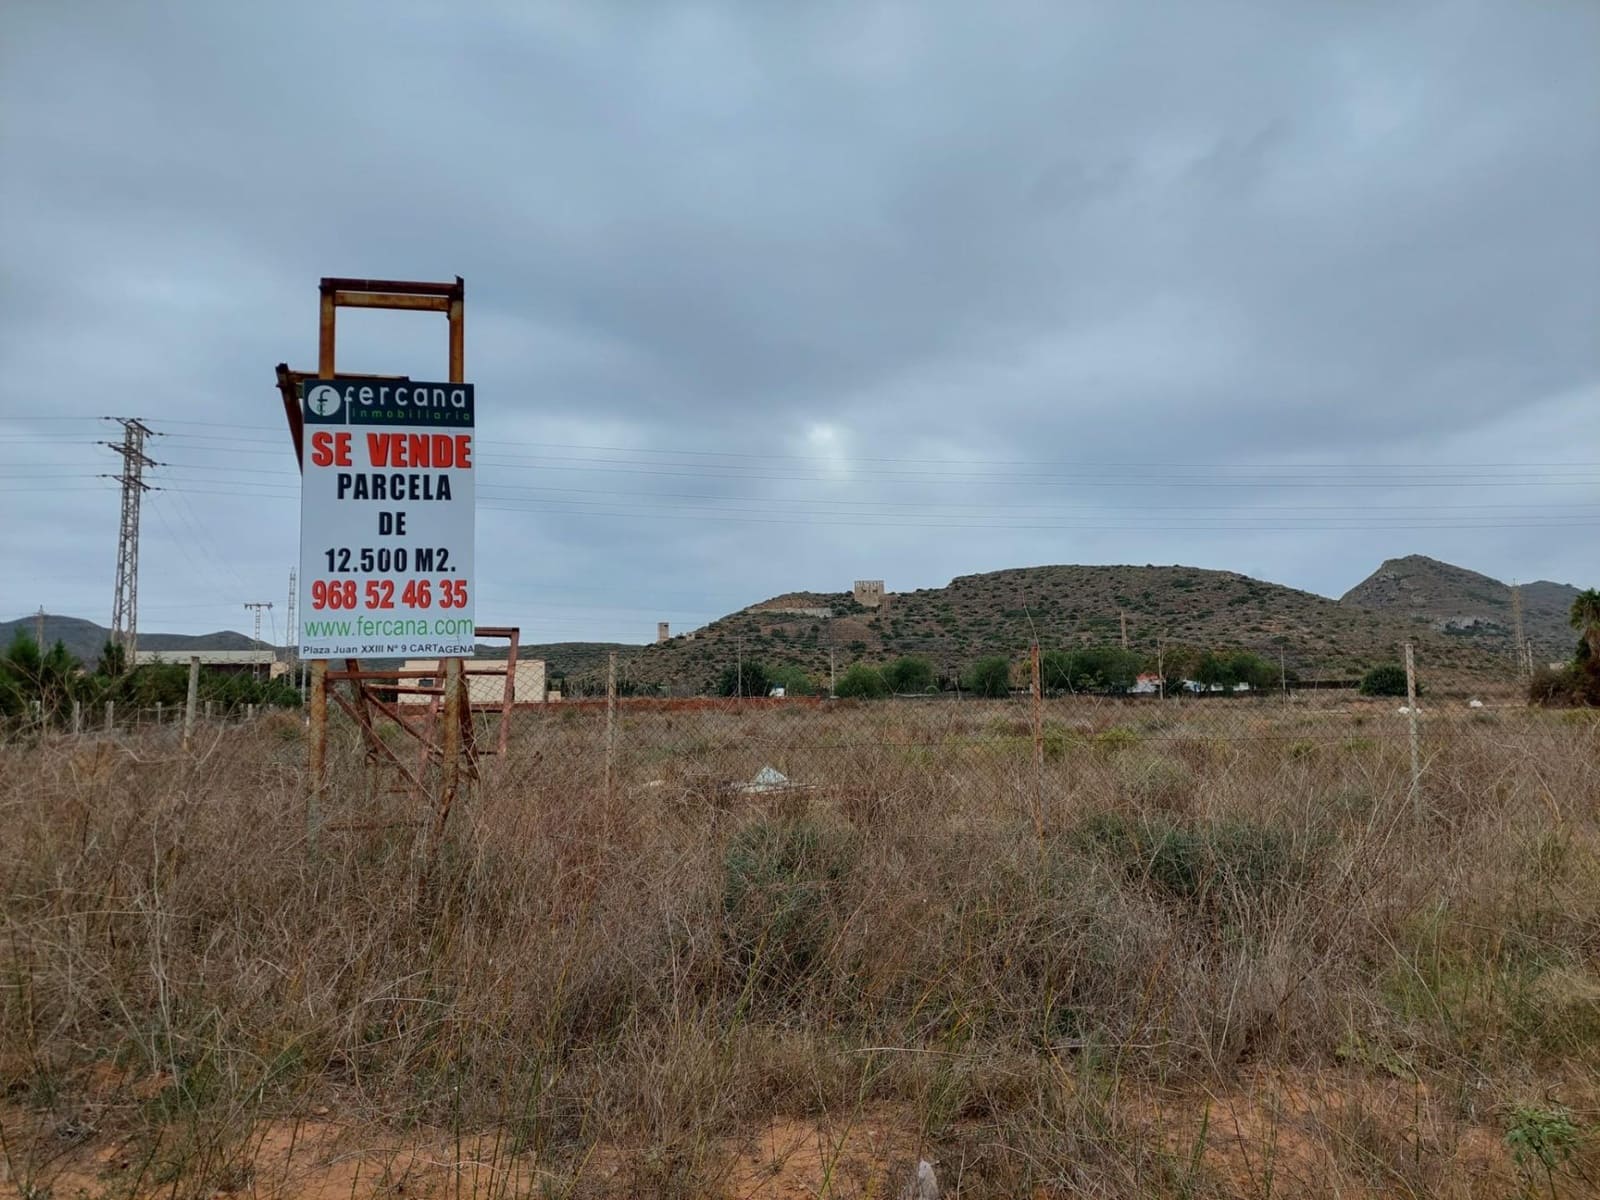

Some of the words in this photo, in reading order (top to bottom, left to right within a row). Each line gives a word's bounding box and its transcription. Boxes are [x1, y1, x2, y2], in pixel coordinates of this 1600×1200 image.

[344, 386, 466, 424] fercana
[352, 408, 470, 421] inmobiliaria
[311, 431, 353, 467] SE
[367, 433, 472, 469] VENDE
[337, 473, 452, 501] PARCELA
[379, 512, 407, 536] DE
[325, 548, 408, 573] 12.500
[415, 548, 456, 572] M2.
[312, 580, 357, 610] 968
[365, 580, 395, 609] 52
[402, 579, 432, 609] 46
[439, 579, 468, 609] 35
[304, 615, 473, 637] www.fercana.com
[303, 645, 331, 654] Plaza
[333, 645, 358, 654] Juan
[361, 645, 384, 654] XXIII
[401, 644, 407, 653] 9
[410, 643, 474, 654] CARTAGENA
